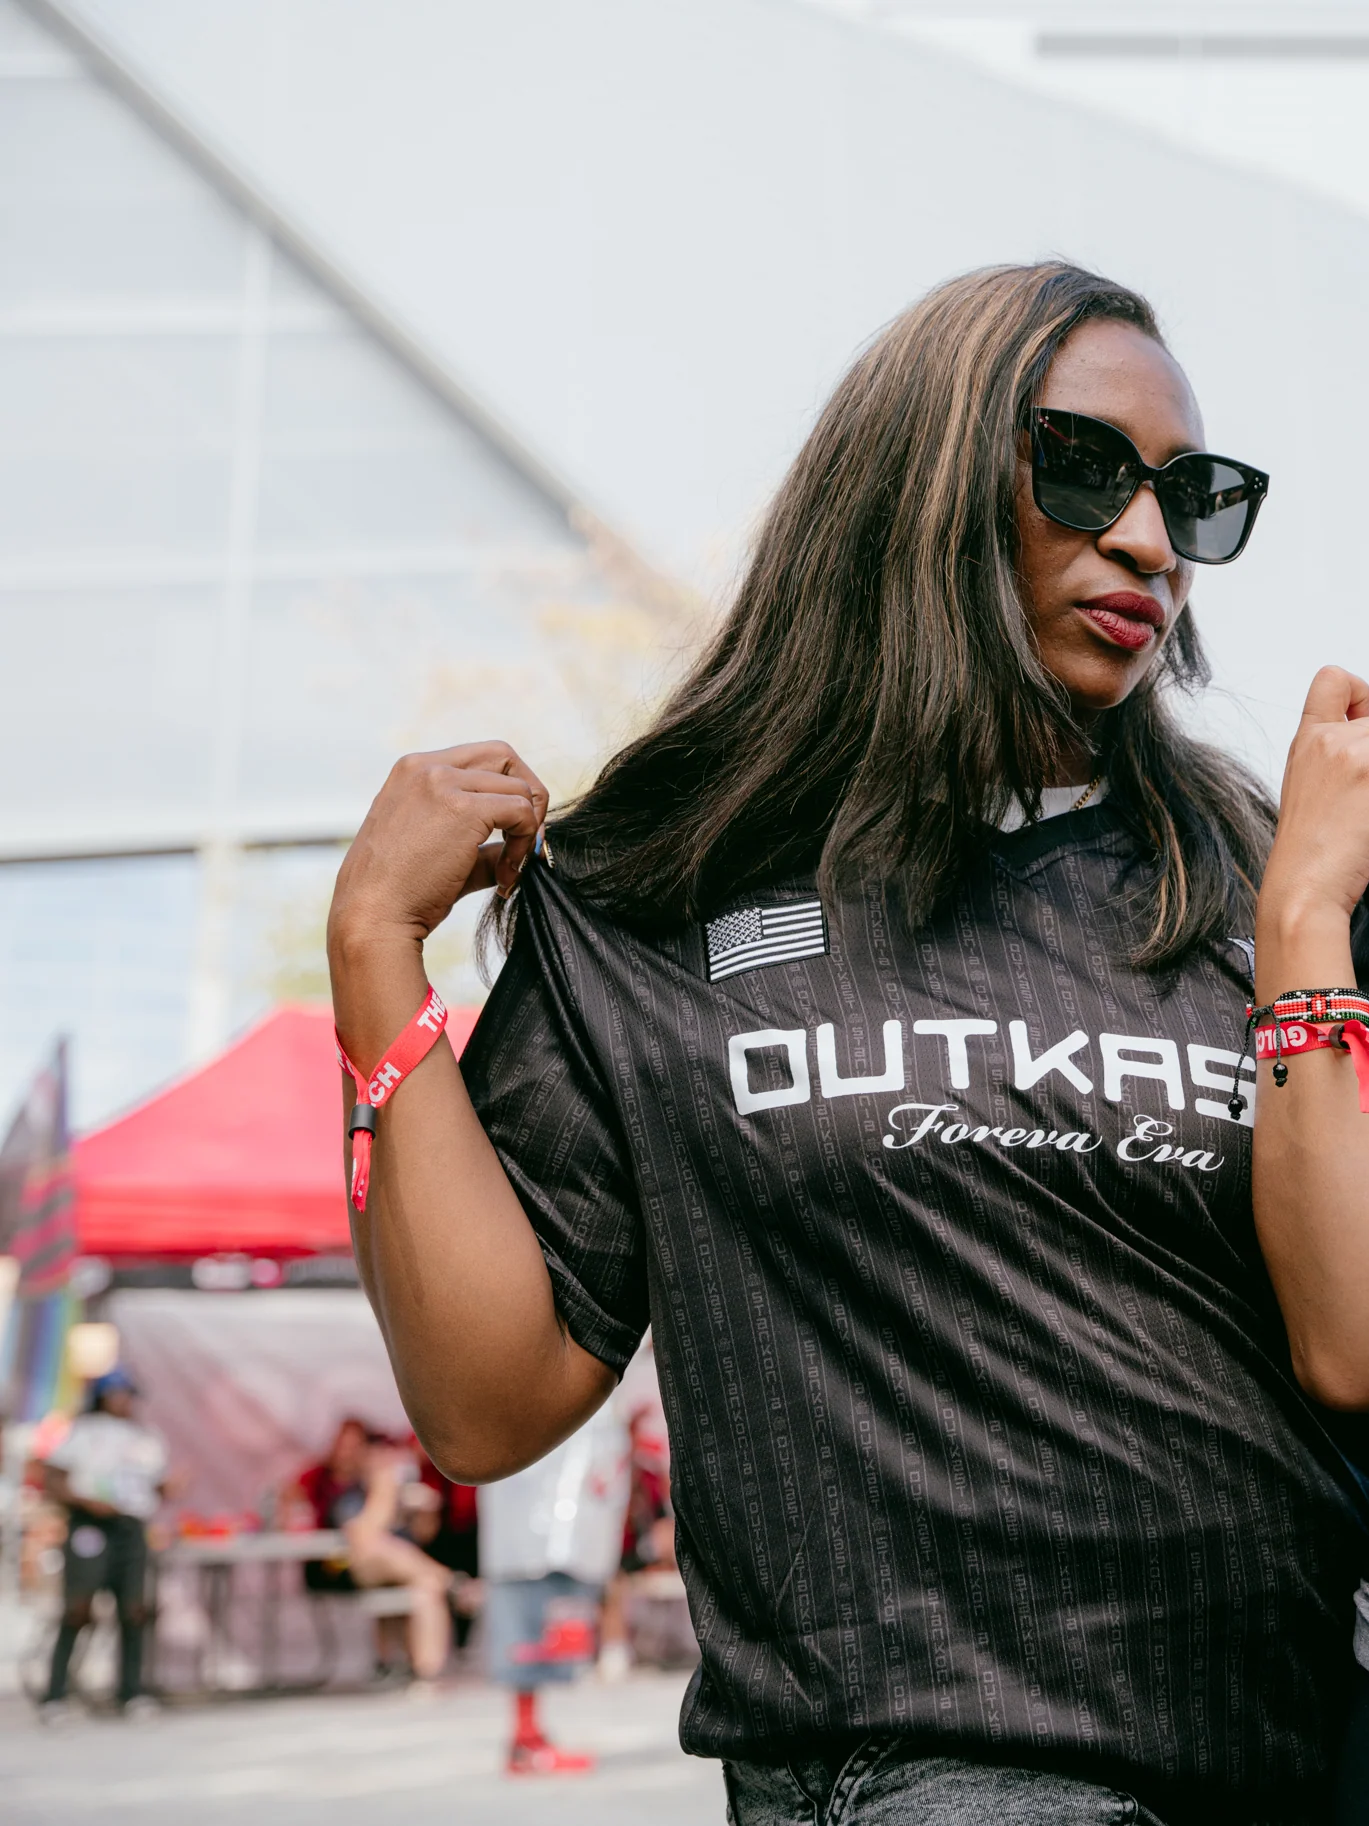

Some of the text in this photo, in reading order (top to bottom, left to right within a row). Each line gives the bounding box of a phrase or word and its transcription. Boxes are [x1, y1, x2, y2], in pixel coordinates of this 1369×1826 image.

[687, 1045, 719, 1158] STANKONIA
[727, 1019, 1256, 1128] OUTKAS
[665, 1105, 704, 1219] STANKONIA
[882, 1103, 1225, 1172] Foreva Eva
[650, 1197, 676, 1283] OUTKAST
[698, 1243, 724, 1331] OUTKAST
[675, 1308, 709, 1426] STANKONIA
[752, 1292, 782, 1410] STANKONIA
[803, 1339, 831, 1458] STANKONIA
[722, 1355, 751, 1475] STANKONIA
[859, 1420, 880, 1510] OUTKAST
[942, 1407, 966, 1498] OUTKAST
[777, 1436, 800, 1528] OUTKAST
[827, 1485, 846, 1575] OUTKAST
[909, 1470, 932, 1559] OUTKAST
[997, 1456, 1019, 1548] OUTKAST
[1170, 1437, 1195, 1523] OUTKAST
[749, 1502, 770, 1591] OUTKAST
[875, 1536, 900, 1659] STANKONIA
[961, 1523, 989, 1646] STANKONIA
[1140, 1499, 1164, 1620] STANKONIA
[1218, 1491, 1243, 1609] STANKONIA
[840, 1603, 865, 1727] STANKONIA
[927, 1588, 952, 1710] STANKONIA
[1190, 1552, 1203, 1670] STANKONIA
[1154, 1644, 1169, 1735] OUTKAST
